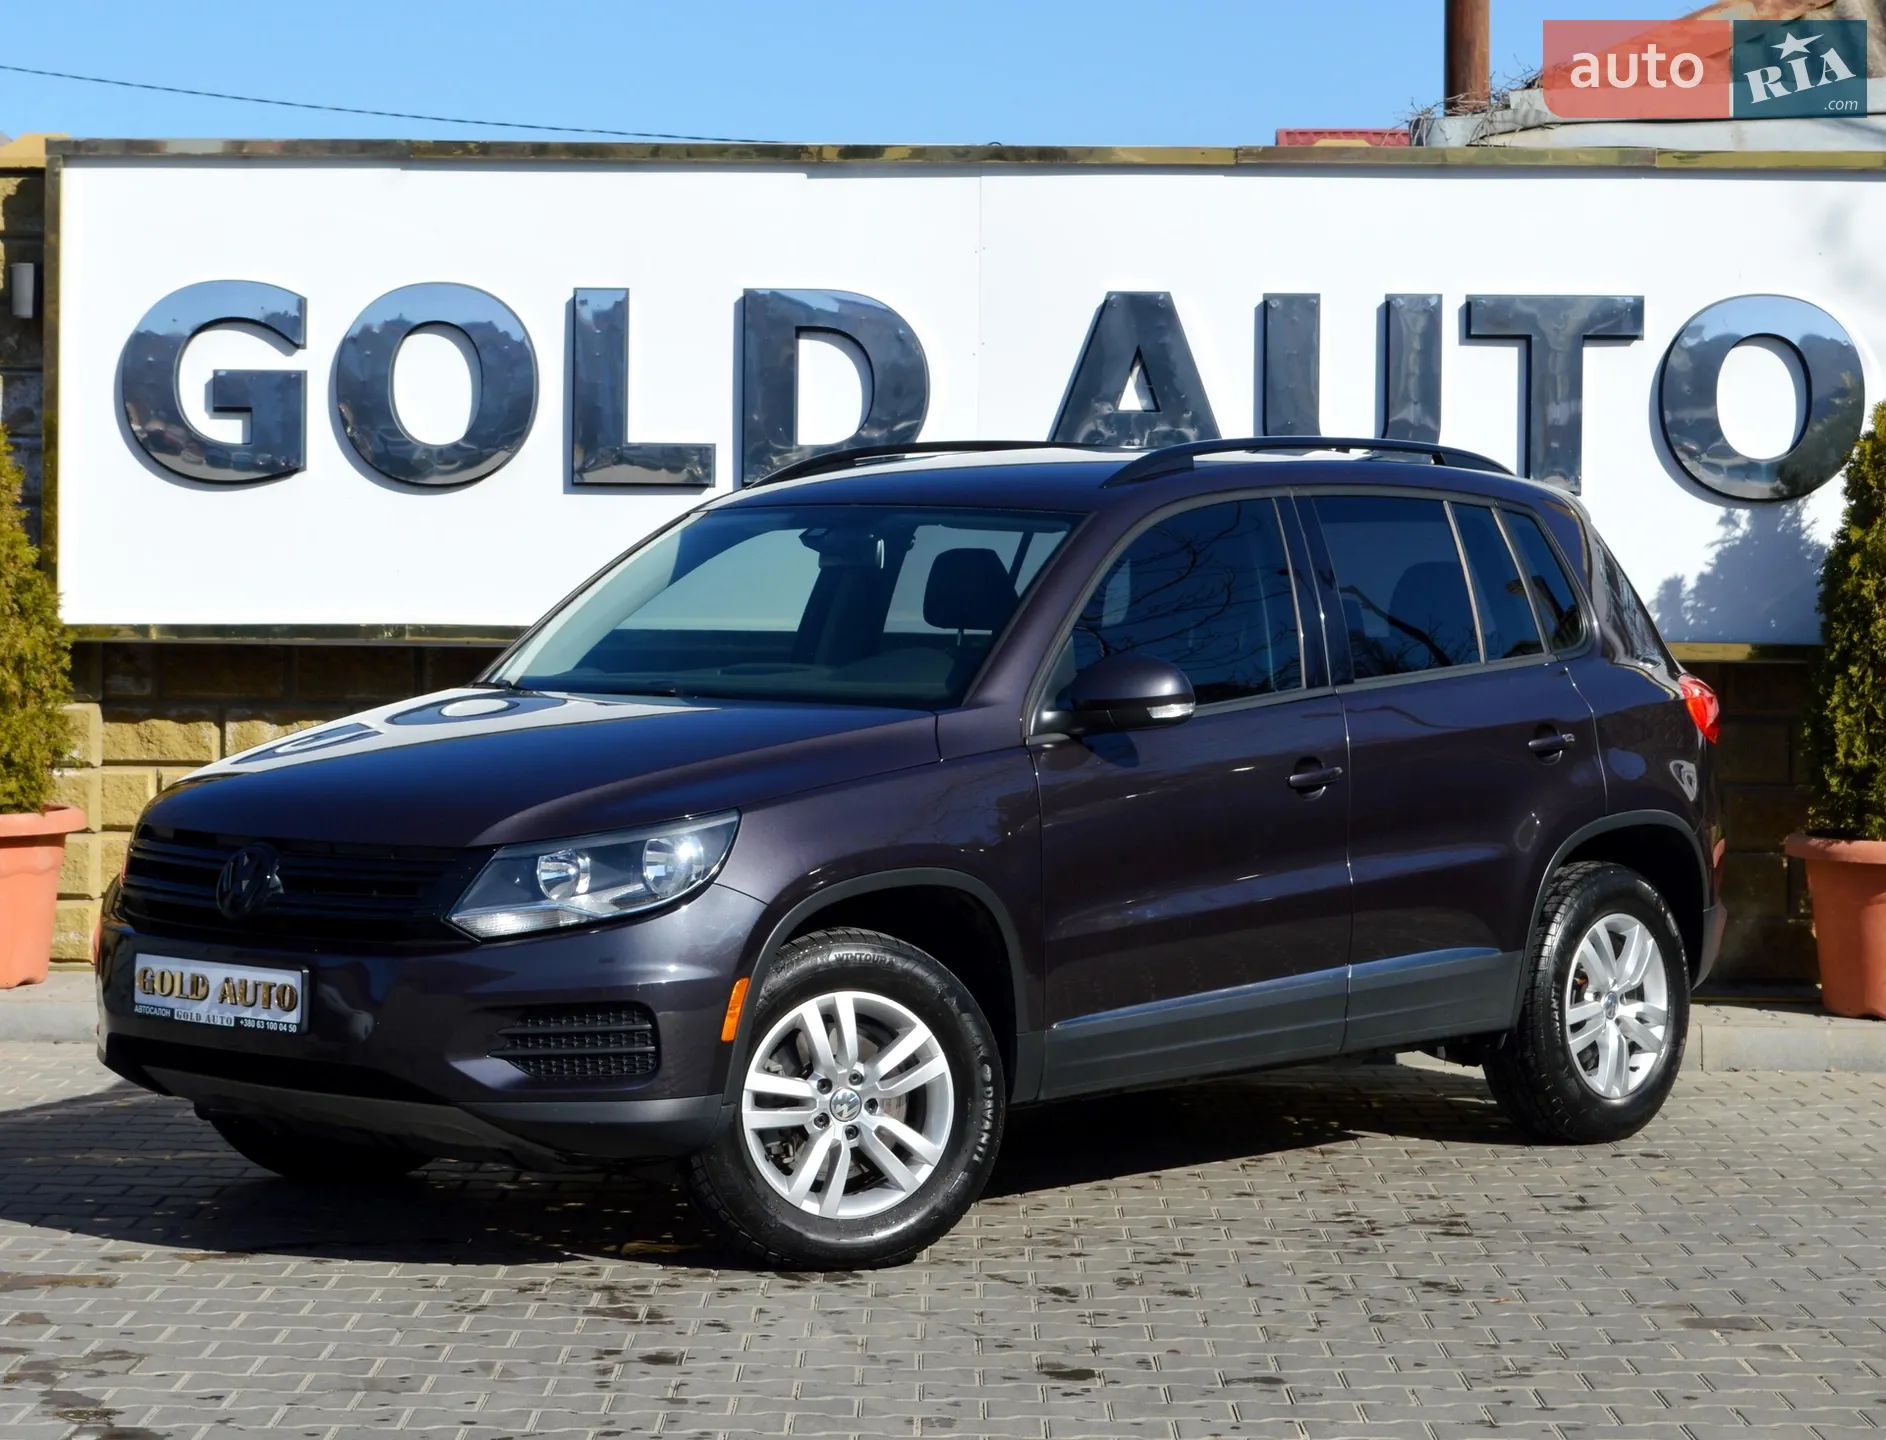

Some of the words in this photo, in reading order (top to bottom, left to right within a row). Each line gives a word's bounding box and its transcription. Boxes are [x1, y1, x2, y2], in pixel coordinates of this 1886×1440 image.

[119, 278, 930, 489] GOLD
[1047, 290, 1865, 501] AUTO
[137, 967, 209, 1000] GOLD
[218, 977, 298, 1011] AUTO
[134, 1005, 171, 1017] АВТОСАЛОН
[176, 1010, 202, 1022] GOLD
[205, 1013, 233, 1026] AUTO
[240, 1018, 255, 1028] +380
[256, 1020, 265, 1029] 63
[266, 1021, 278, 1031] 100
[279, 1022, 288, 1032] 04
[288, 1024, 298, 1033] 50
